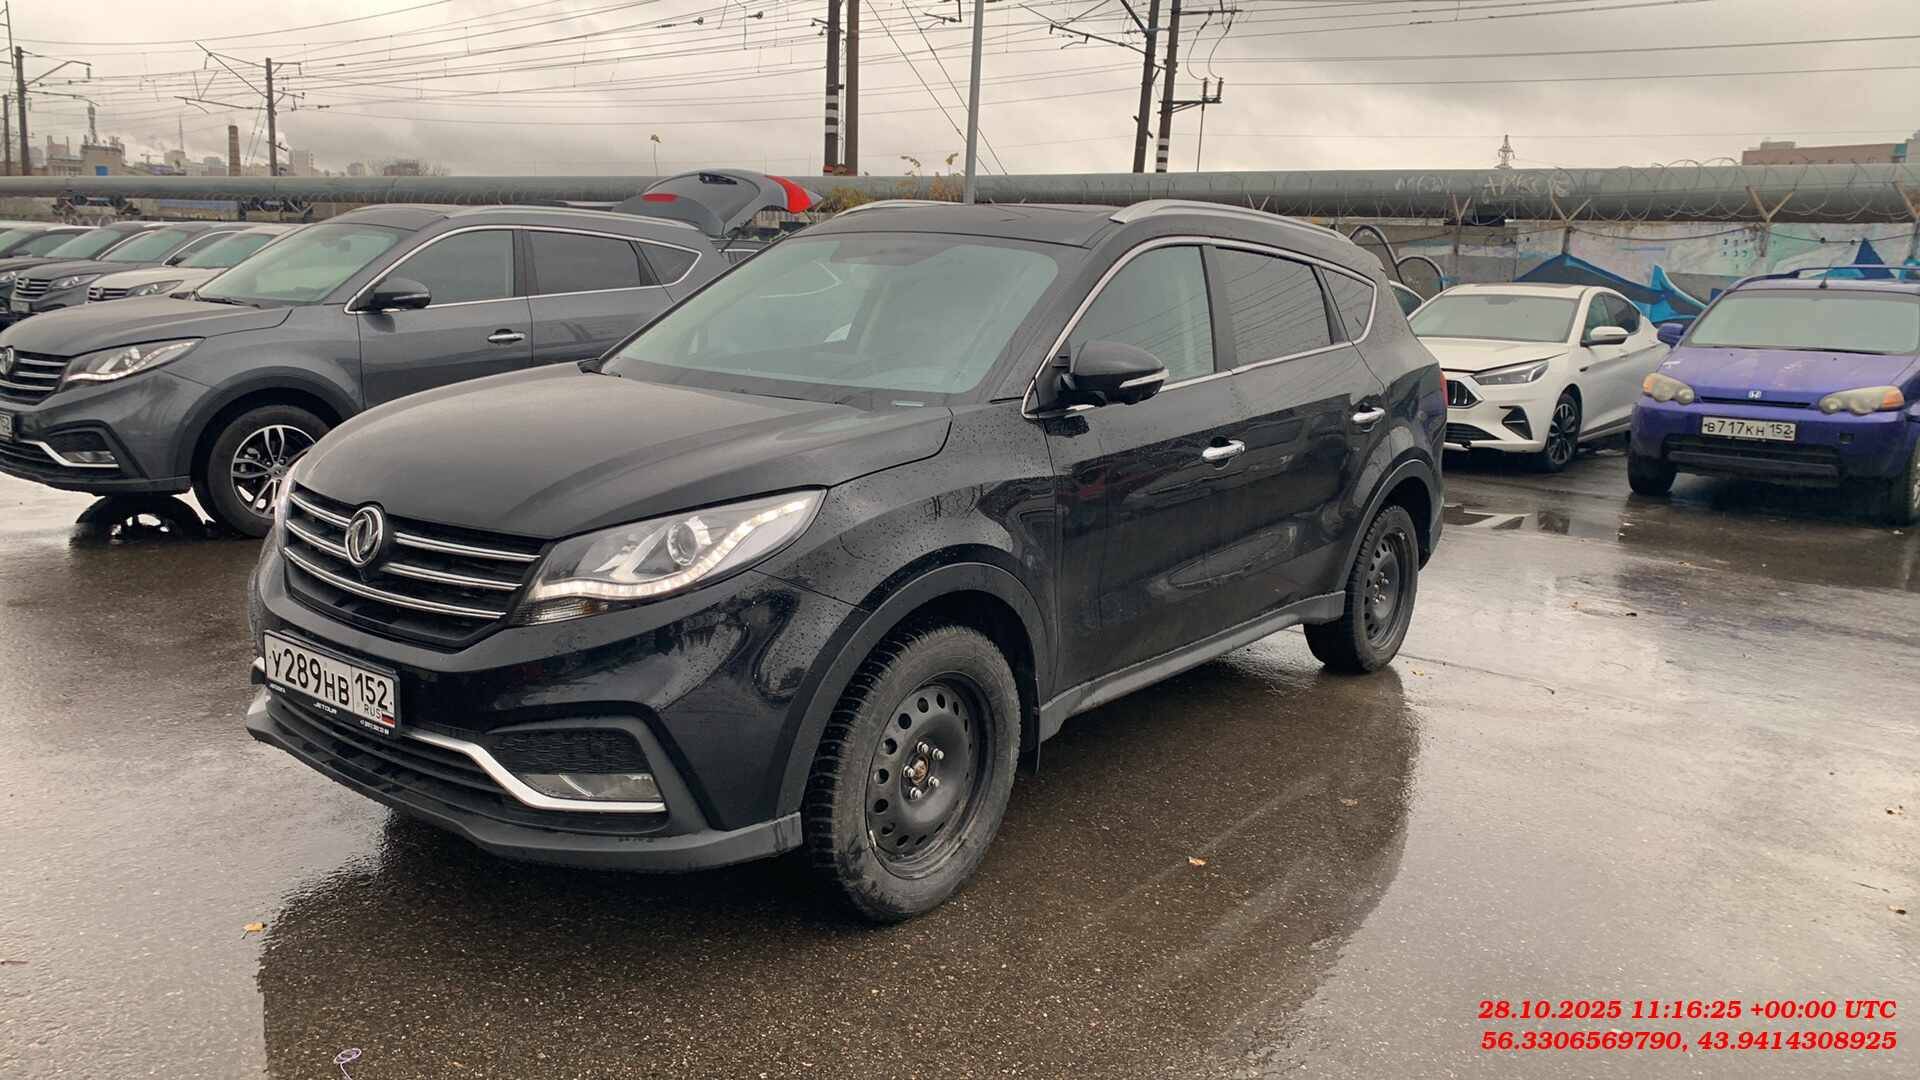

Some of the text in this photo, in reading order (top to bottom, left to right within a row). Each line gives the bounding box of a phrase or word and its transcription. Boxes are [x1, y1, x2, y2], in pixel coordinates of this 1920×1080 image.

[1769, 423, 1792, 435] 152
[272, 648, 388, 710] У289НВ 152
[364, 703, 382, 720] RUS
